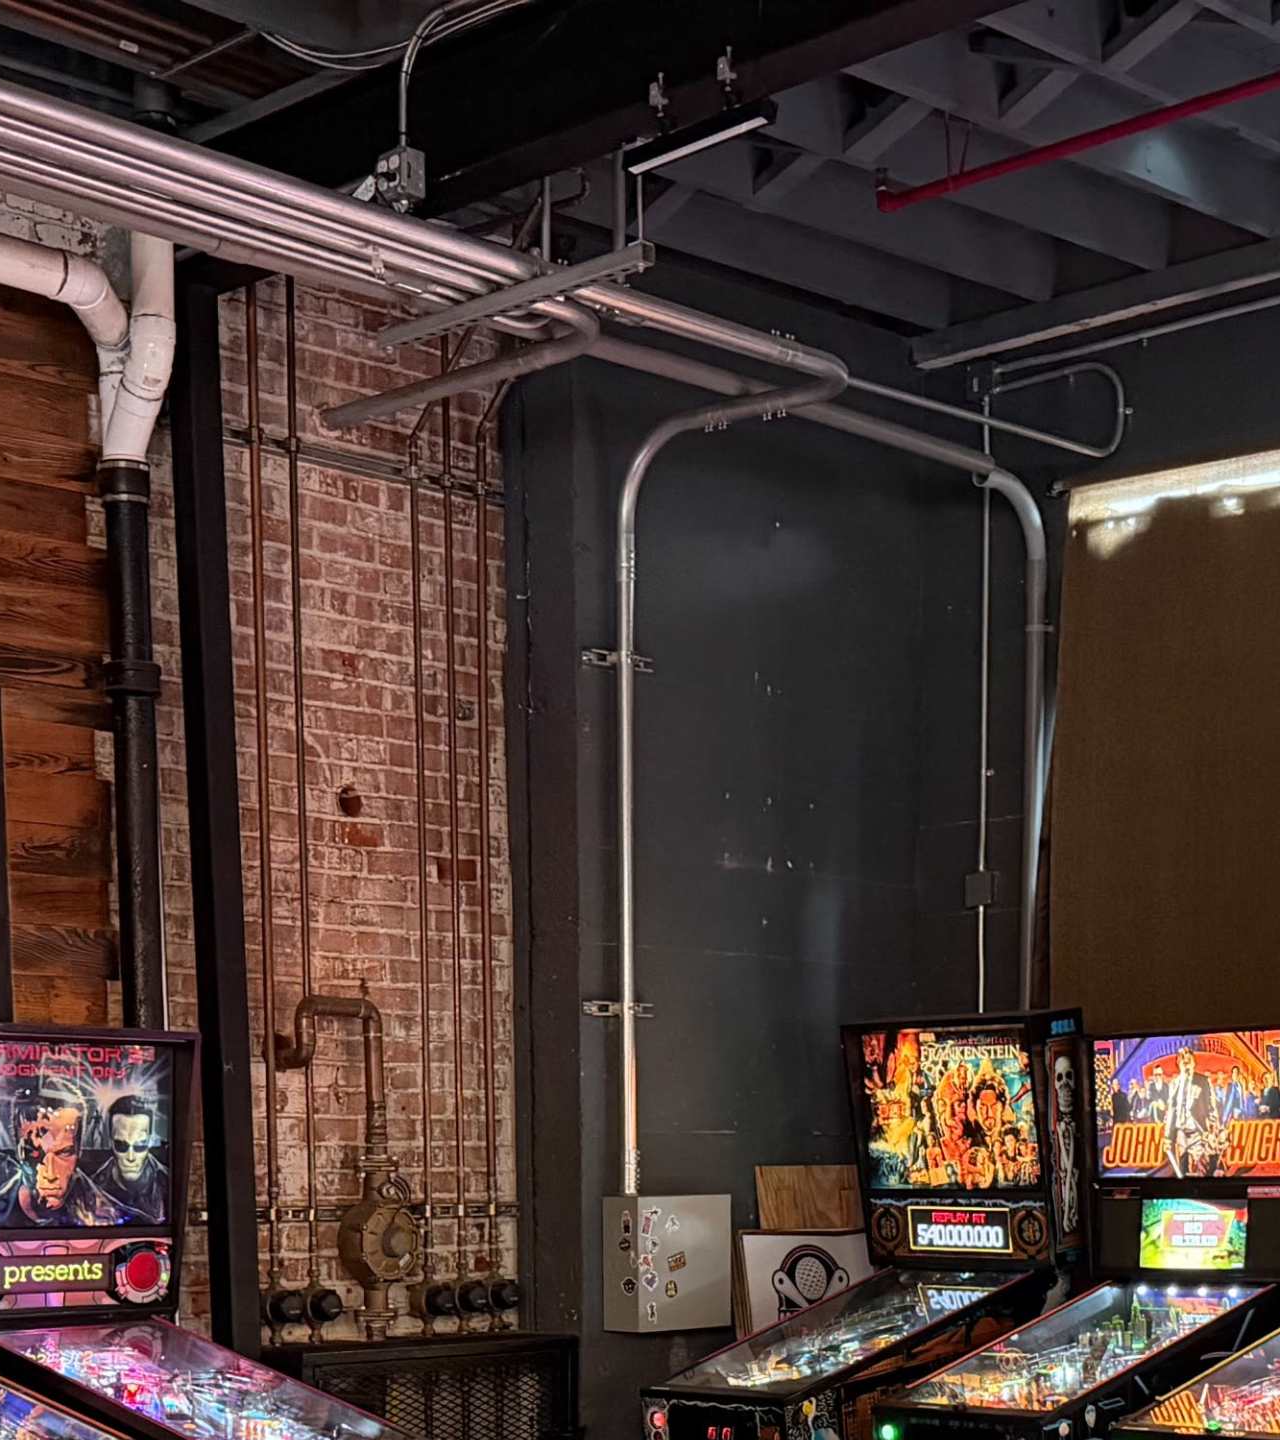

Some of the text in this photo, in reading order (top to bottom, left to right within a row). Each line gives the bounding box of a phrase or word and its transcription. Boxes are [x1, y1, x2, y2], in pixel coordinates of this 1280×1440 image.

[920, 1045, 1020, 1062] FRANKENSTEIN
[93, 1067, 128, 1080] DAY
[1104, 1122, 1168, 1168] JOHN
[931, 1212, 987, 1225] REPLAY AT
[3, 1260, 104, 1289] presents
